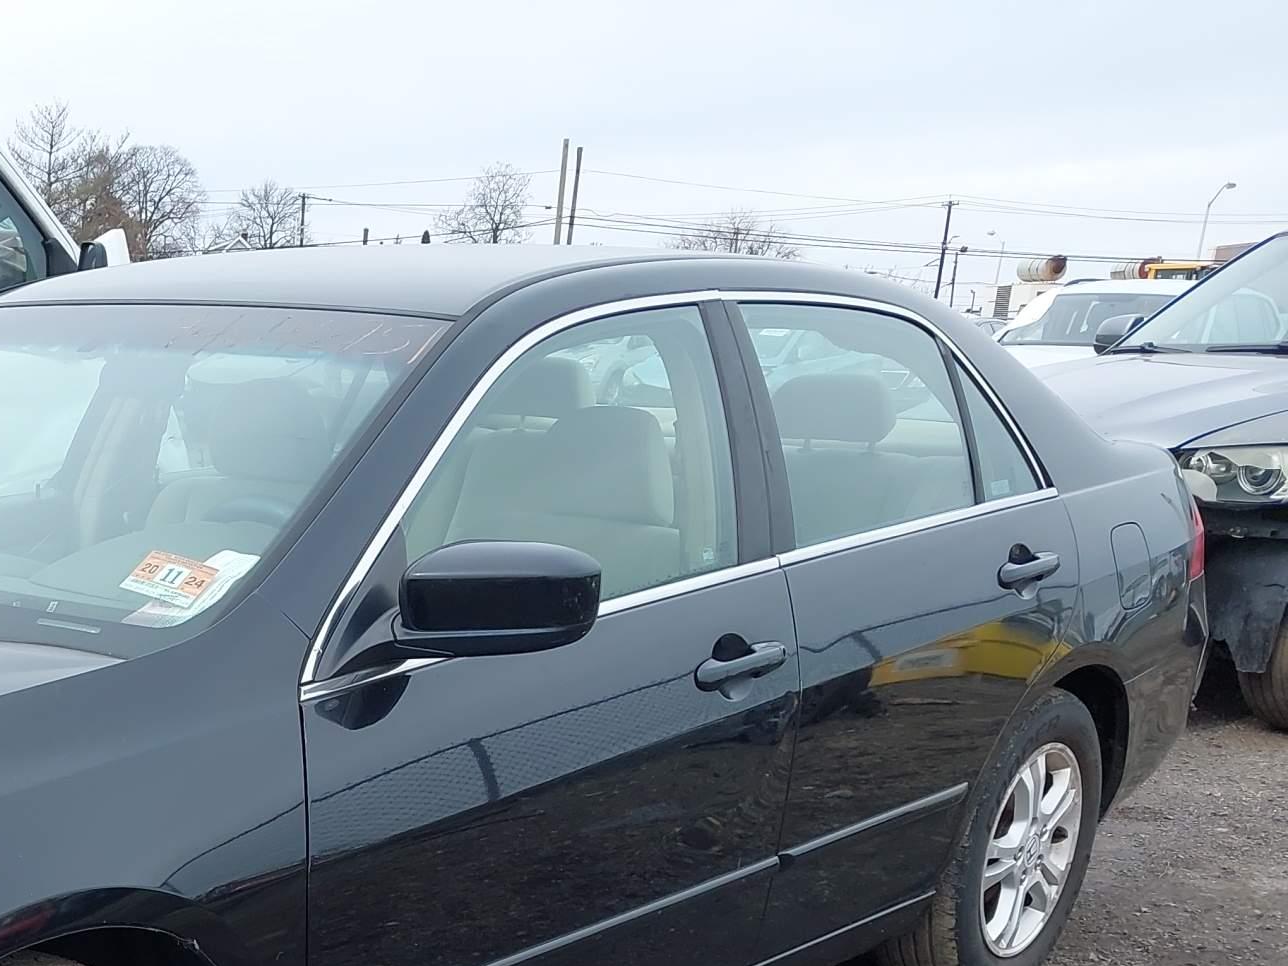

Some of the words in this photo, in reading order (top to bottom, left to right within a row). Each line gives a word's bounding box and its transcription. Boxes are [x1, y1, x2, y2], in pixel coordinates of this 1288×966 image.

[141, 562, 159, 575] 20
[160, 567, 183, 584] 11
[184, 576, 206, 589] 24
